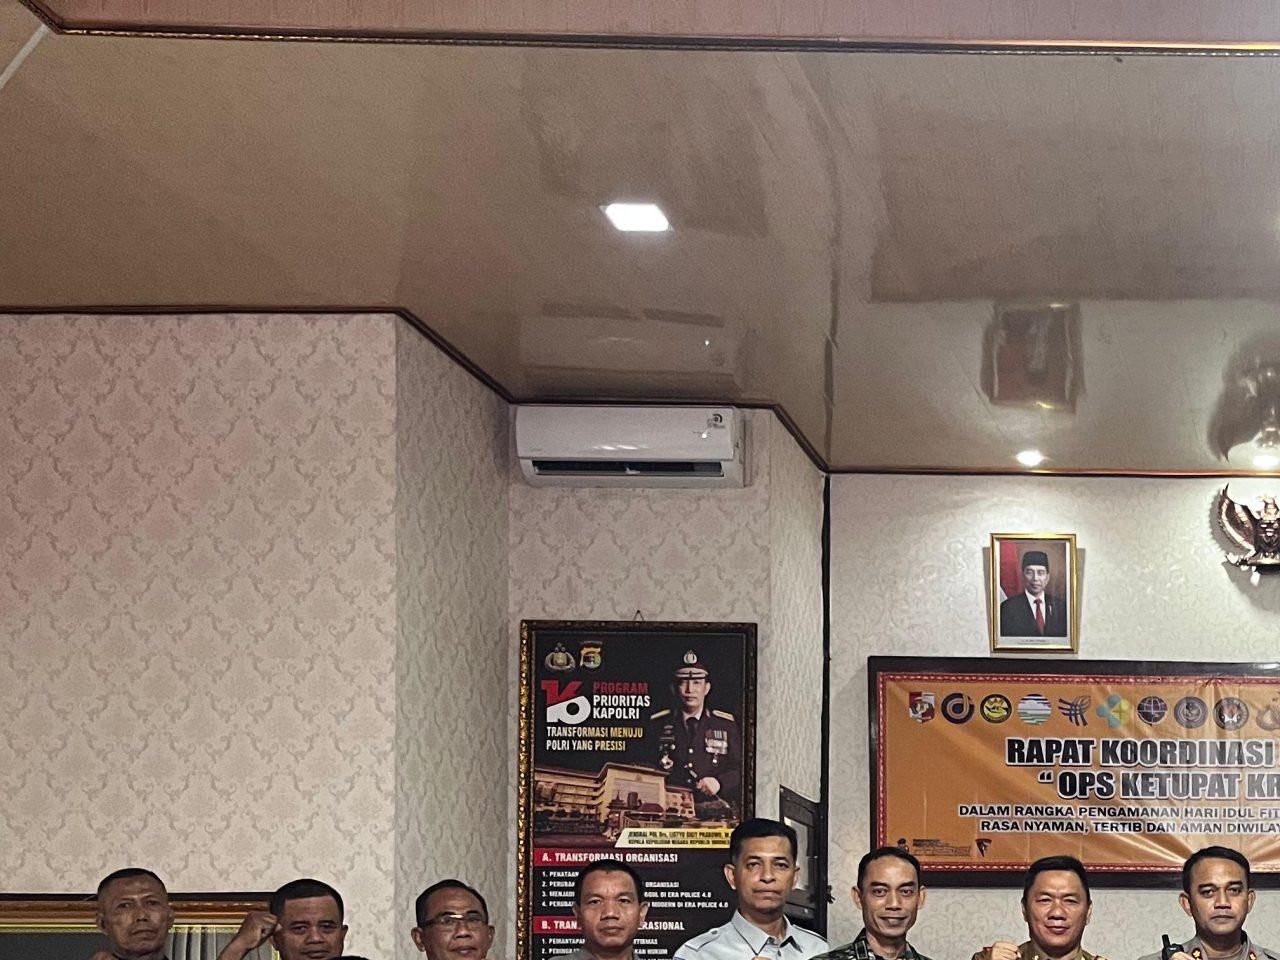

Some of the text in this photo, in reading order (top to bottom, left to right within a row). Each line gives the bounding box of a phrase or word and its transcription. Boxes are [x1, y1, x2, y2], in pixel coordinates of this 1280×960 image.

[593, 682, 649, 694] PROGRAM
[593, 695, 651, 707] PRIORITAS
[593, 707, 640, 719] KAPOLRI
[546, 726, 643, 738] TRANSFORMASI MENUJU
[546, 739, 626, 751] POLRI YANG PRESISI
[1007, 738, 1095, 765] RAPAT
[1101, 739, 1274, 766] KOORDINASI
[1058, 771, 1115, 798] OPS
[1121, 771, 1241, 798] KETUPAT
[959, 805, 1010, 816] DALAM
[1014, 806, 1074, 817] RANGKA
[1079, 806, 1180, 817] PENGAMANAN
[1184, 807, 1218, 818] HARI
[1222, 807, 1255, 818] IDUL
[981, 820, 1019, 831] RASA
[1024, 821, 1089, 834] NYAMAN,
[1093, 822, 1142, 832] TERTIB
[1146, 822, 1176, 832] DAN
[1180, 823, 1222, 833] AMAN
[542, 853, 551, 862] A.
[626, 854, 678, 863] ORGANISASI
[542, 921, 551, 930] B.
